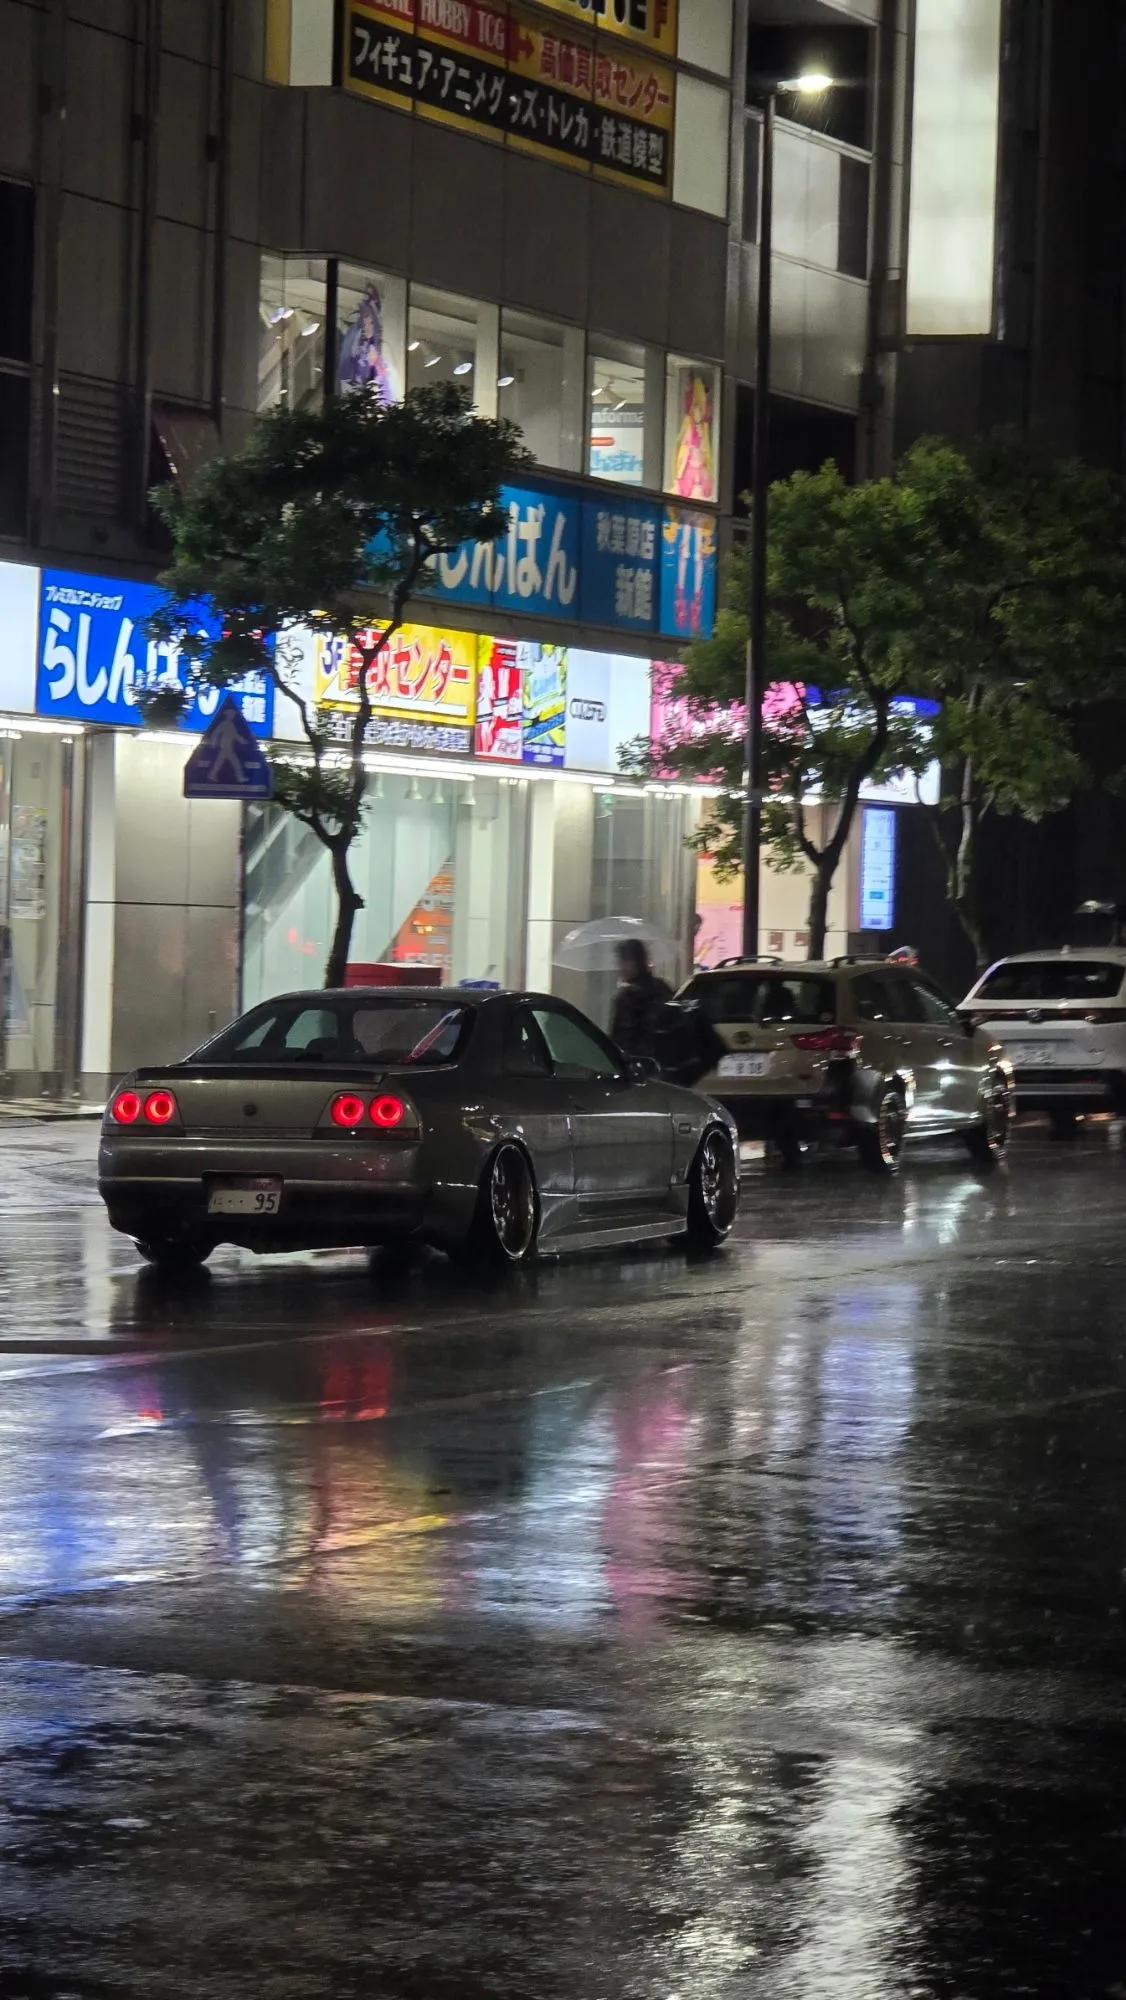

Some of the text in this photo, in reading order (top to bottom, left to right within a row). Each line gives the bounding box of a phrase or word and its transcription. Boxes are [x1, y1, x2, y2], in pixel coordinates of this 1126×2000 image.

[477, 10, 505, 50] TCG
[424, 500, 577, 605] しんばん
